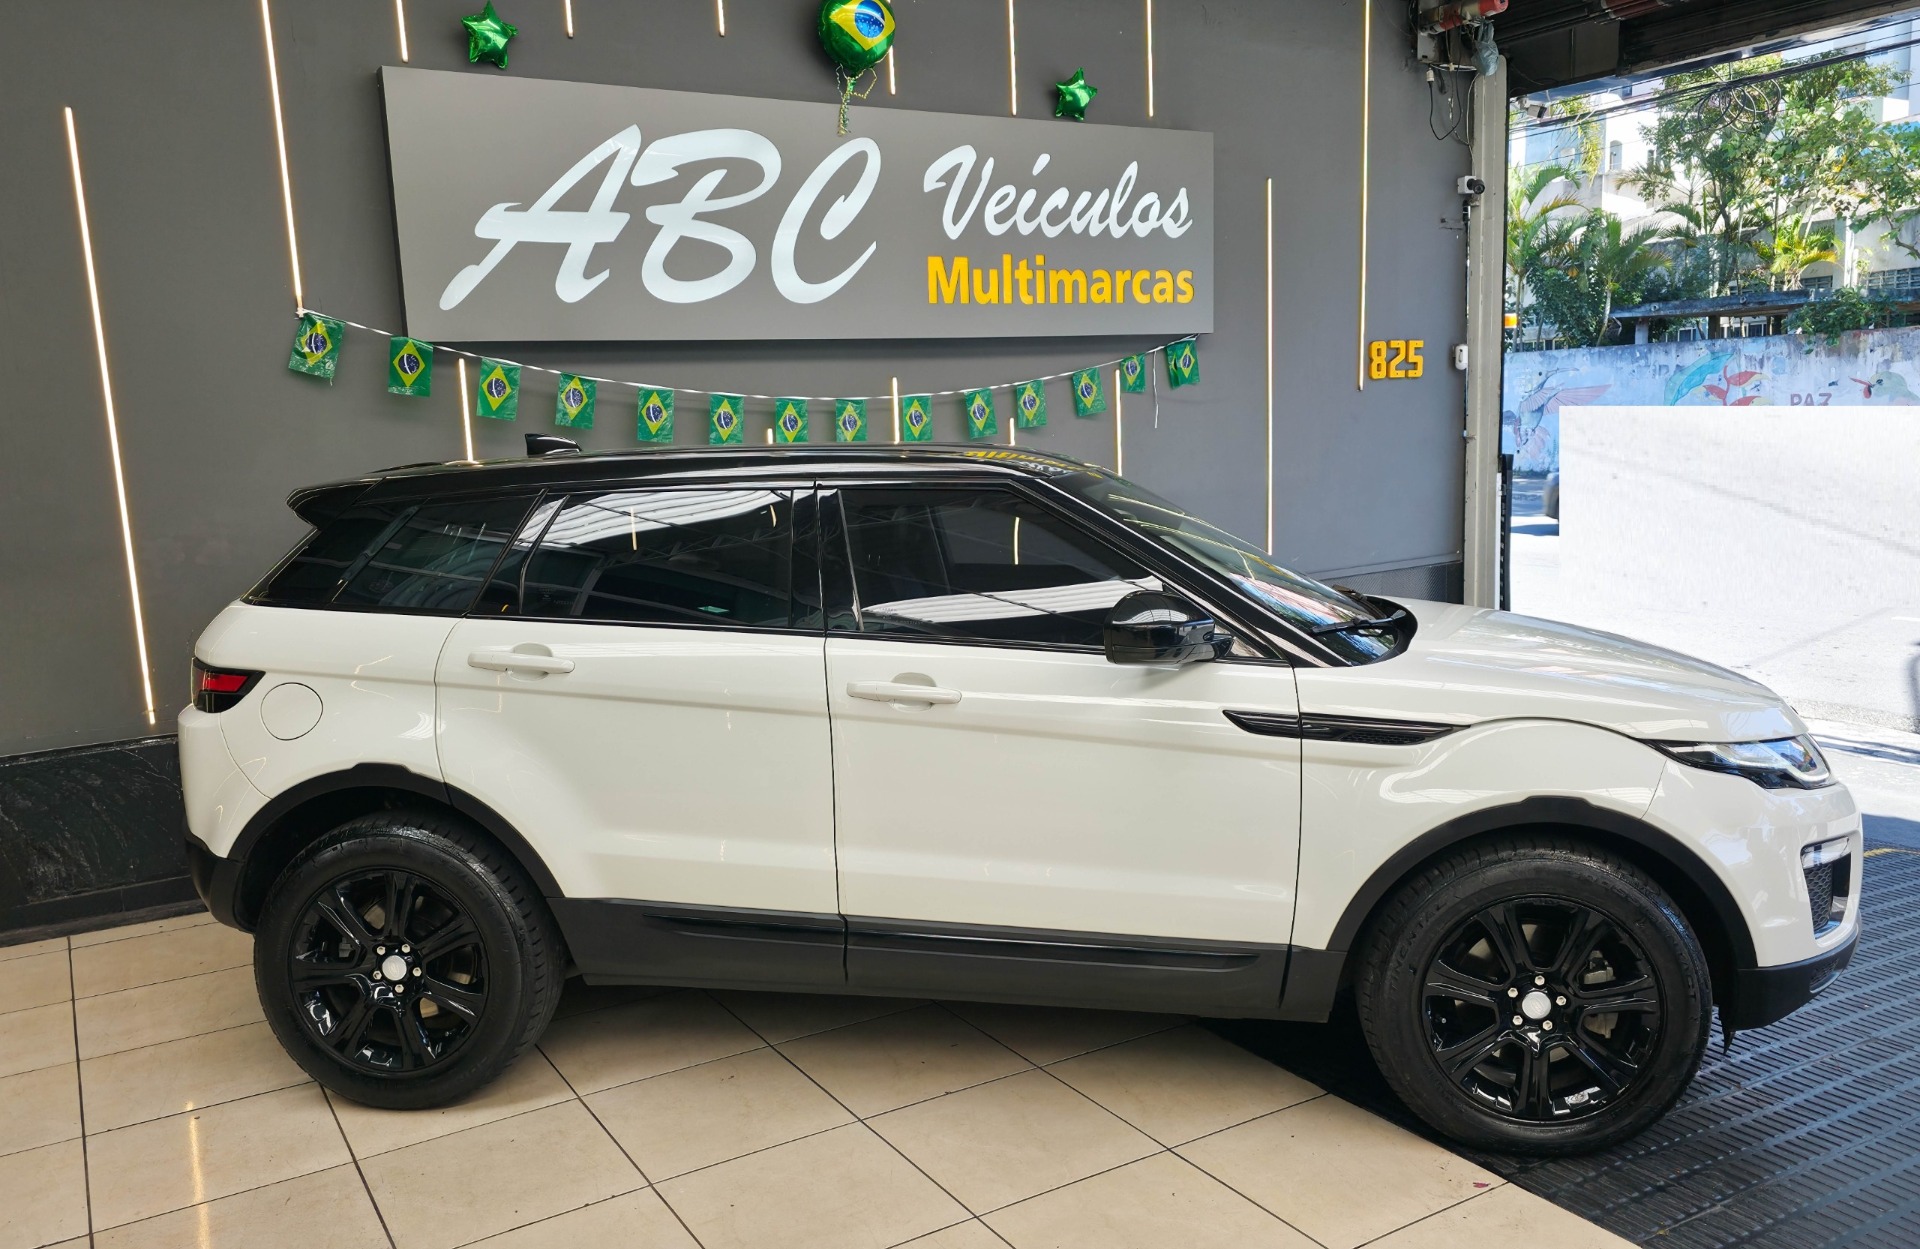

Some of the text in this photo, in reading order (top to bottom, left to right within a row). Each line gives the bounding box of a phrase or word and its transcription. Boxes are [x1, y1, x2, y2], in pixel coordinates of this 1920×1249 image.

[439, 123, 1193, 311] ABC Veículos
[926, 253, 1195, 305] Multimarcas
[1368, 339, 1425, 380] 825
[1790, 392, 1833, 407] PAZ
